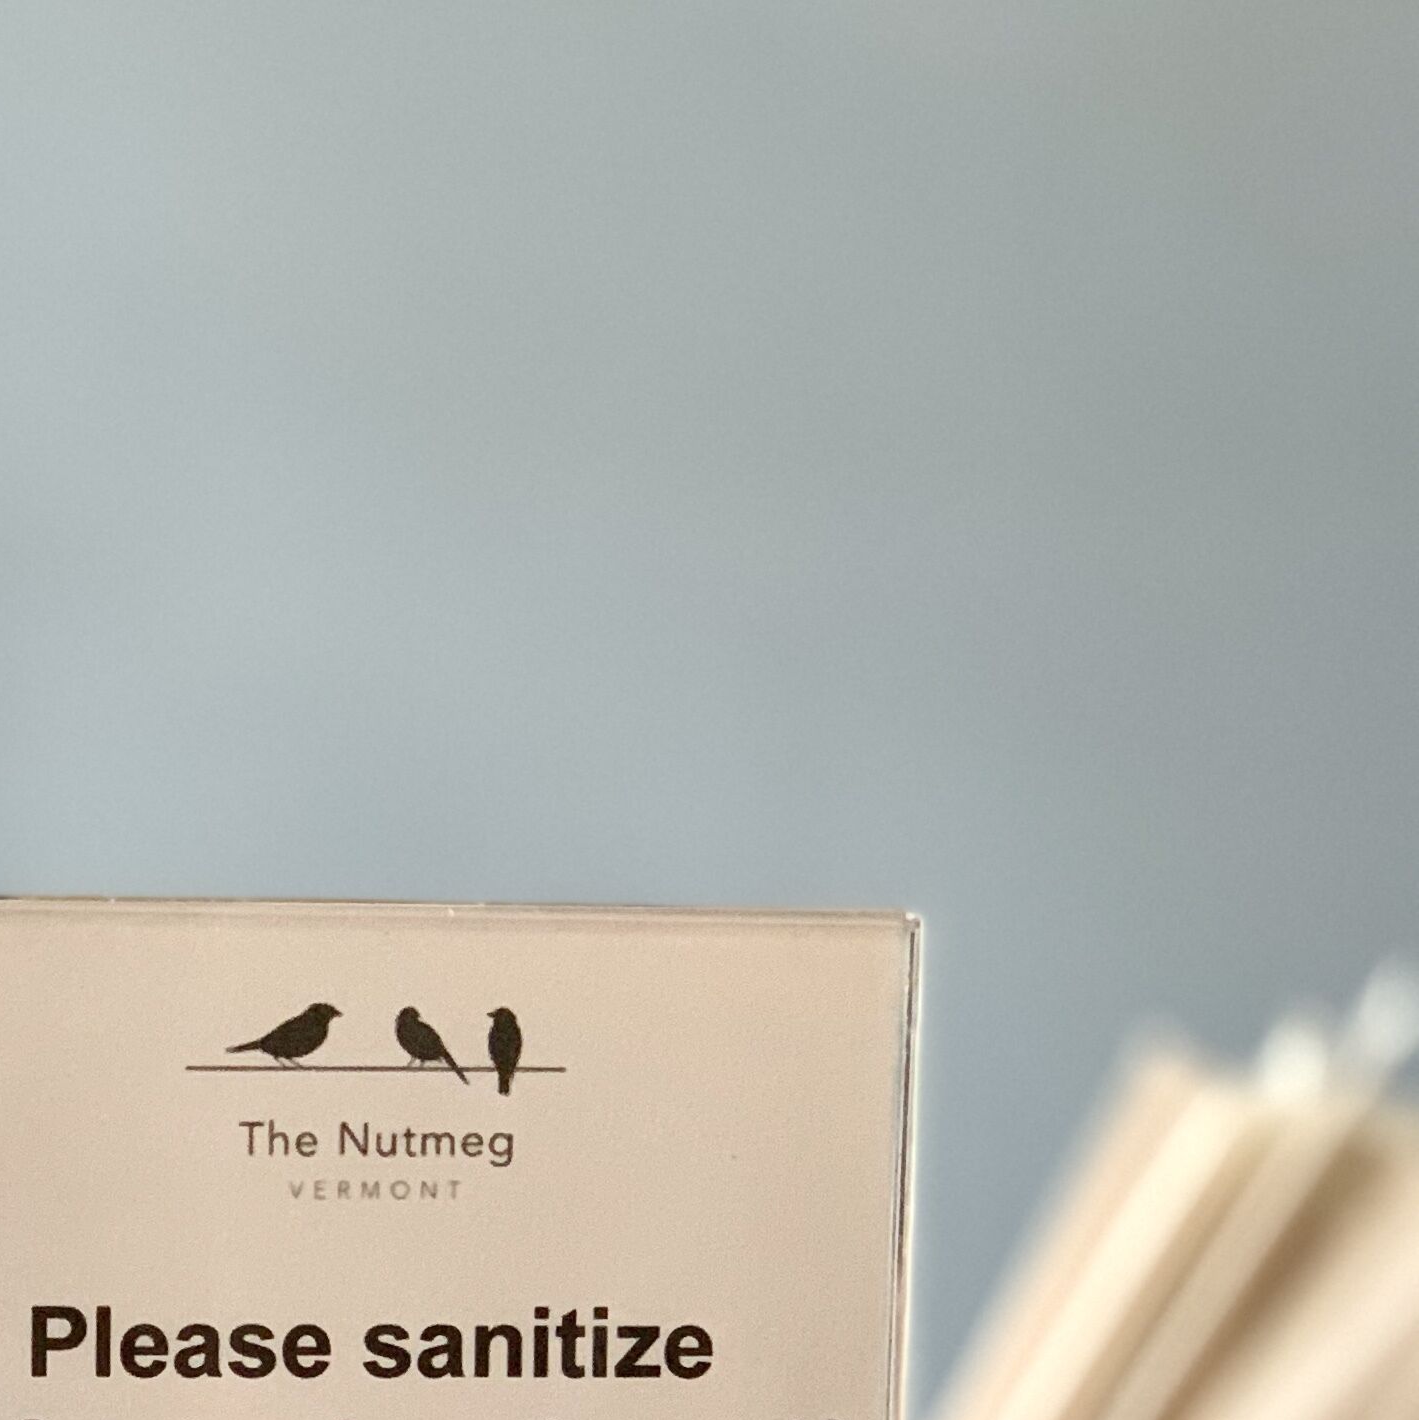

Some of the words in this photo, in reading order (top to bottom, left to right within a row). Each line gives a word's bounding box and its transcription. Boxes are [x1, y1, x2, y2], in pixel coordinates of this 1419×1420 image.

[238, 1120, 318, 1159] The
[339, 1121, 515, 1168] Nutmeg
[288, 1179, 463, 1202] VERMONT
[31, 1305, 331, 1380] Please
[362, 1306, 713, 1380] sanitize
